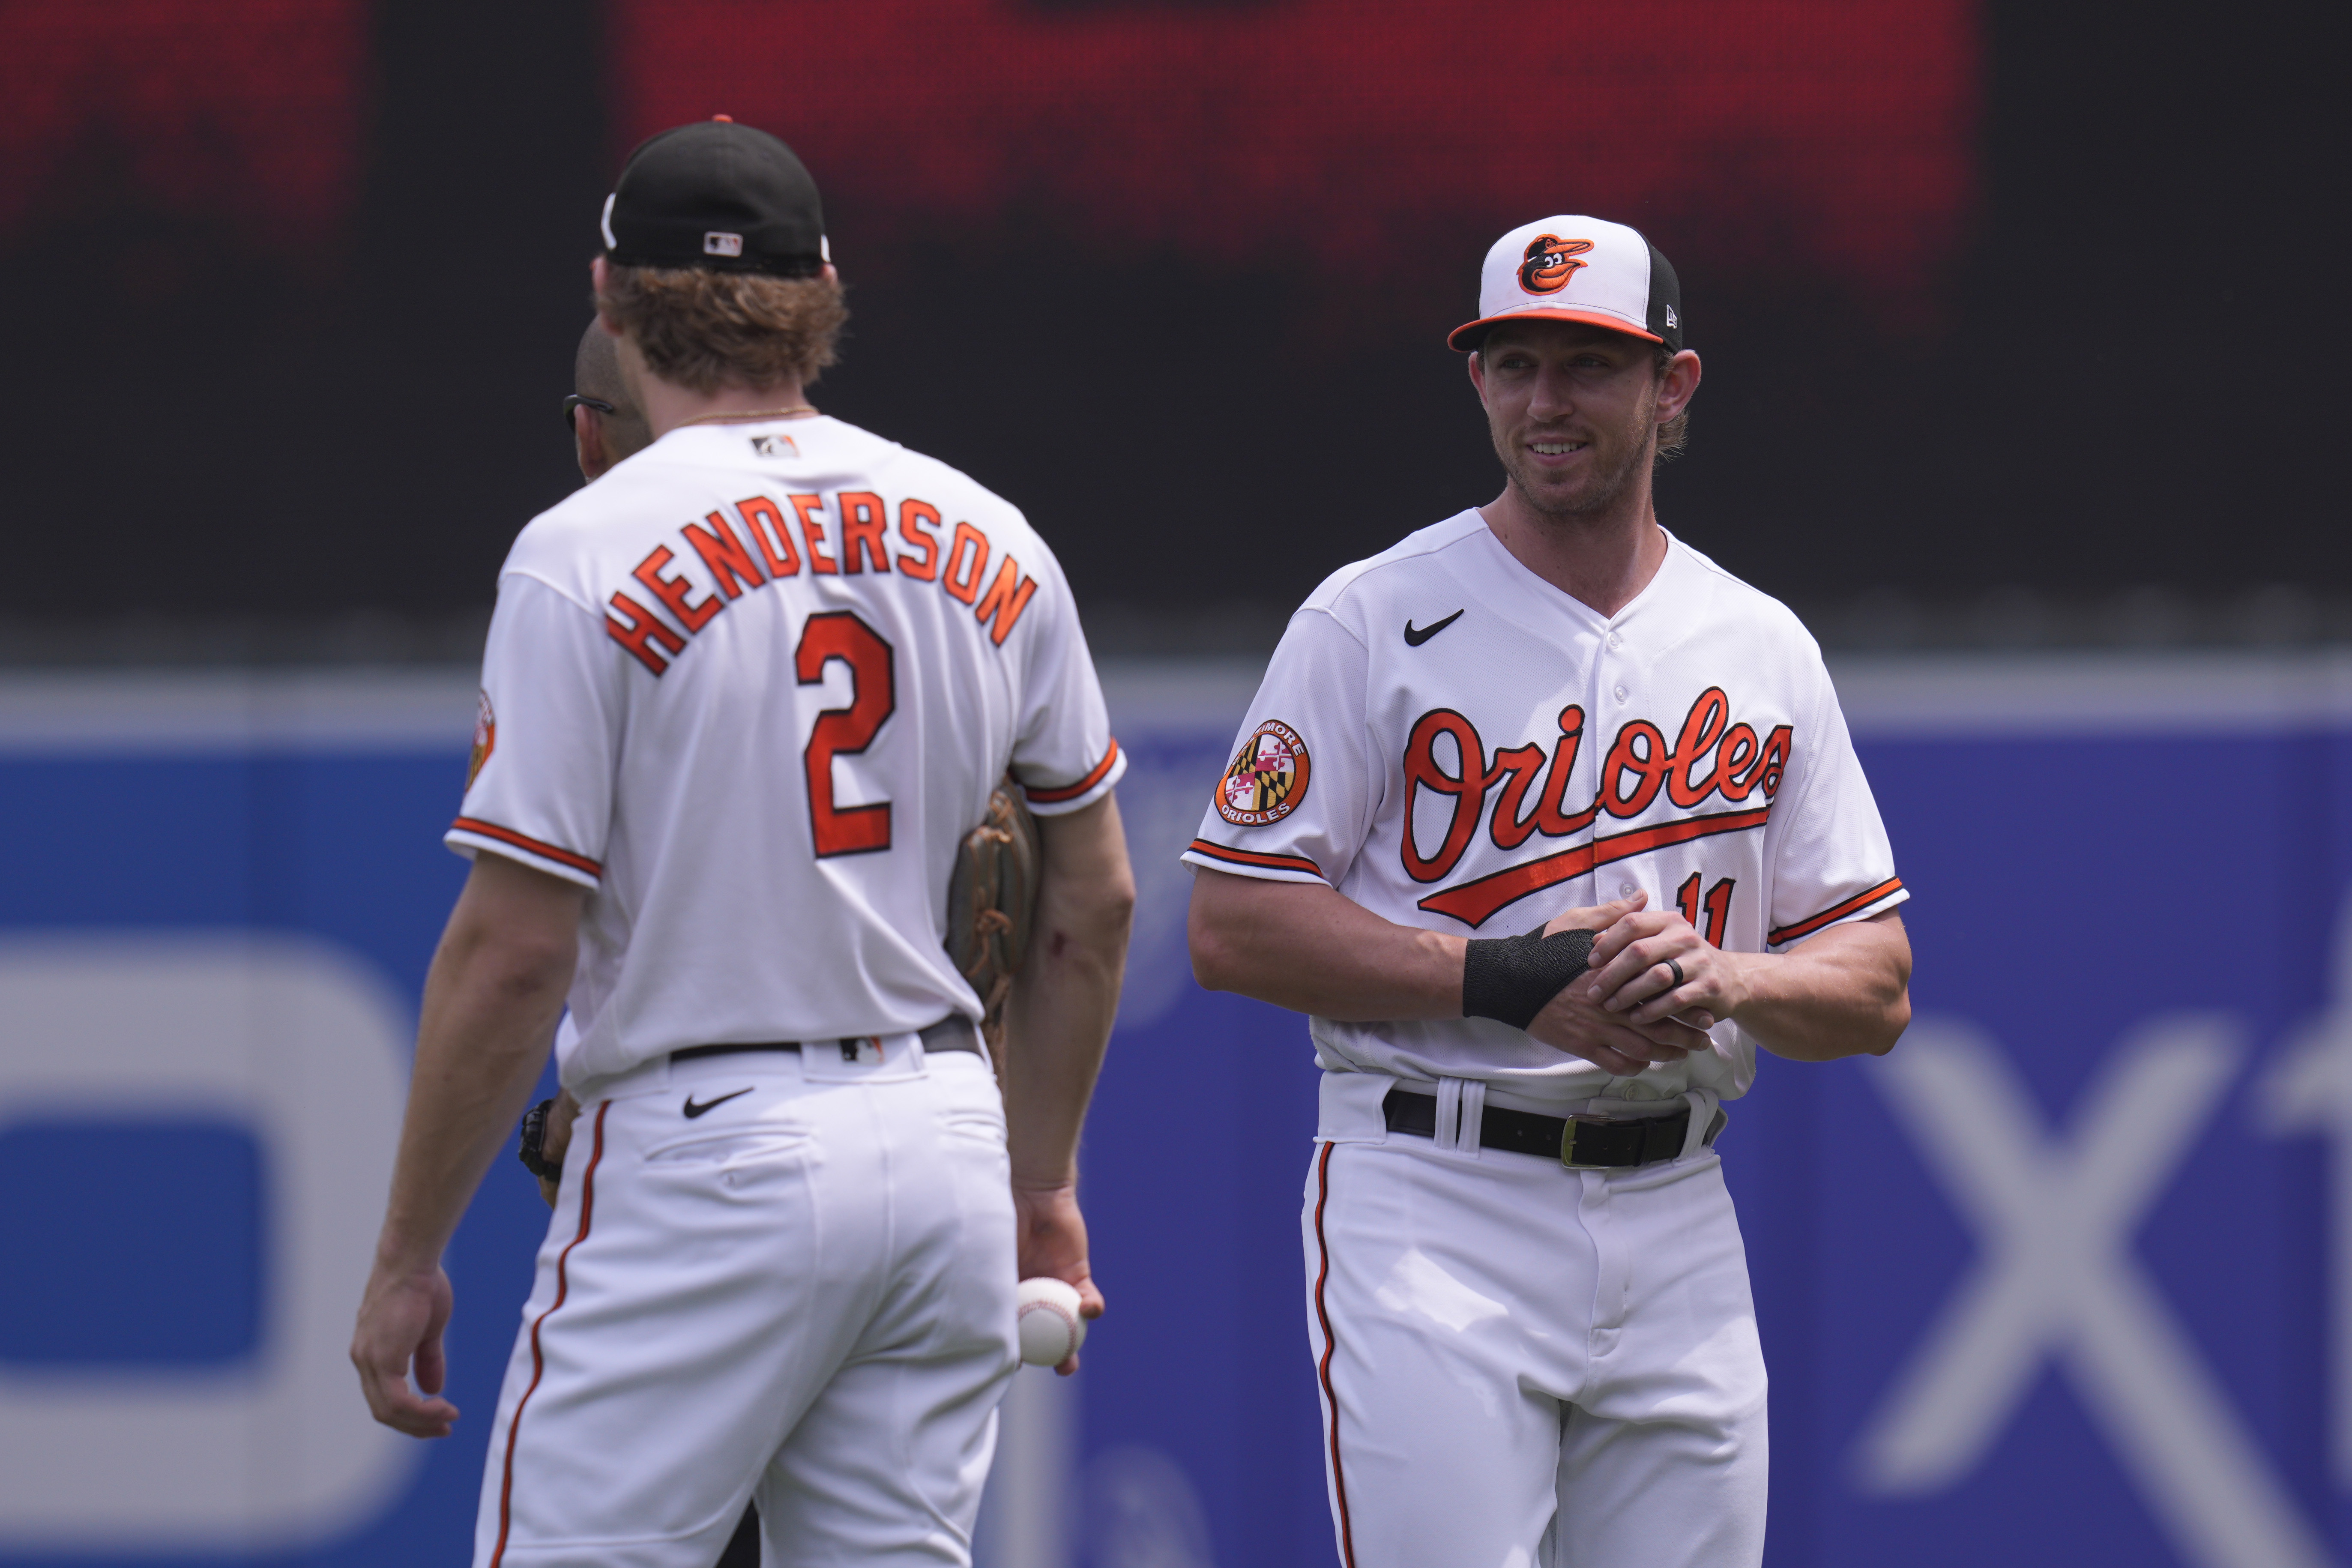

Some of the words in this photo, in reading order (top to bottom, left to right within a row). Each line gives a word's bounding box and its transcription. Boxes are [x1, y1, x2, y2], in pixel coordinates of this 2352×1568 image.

[604, 491, 1038, 678] HENDERSON
[795, 610, 895, 860] 2
[1232, 722, 1305, 766] TIMORE
[1400, 686, 1794, 883] Orioles
[1221, 802, 1290, 824] ORIOLES
[1676, 871, 1737, 950] 11
